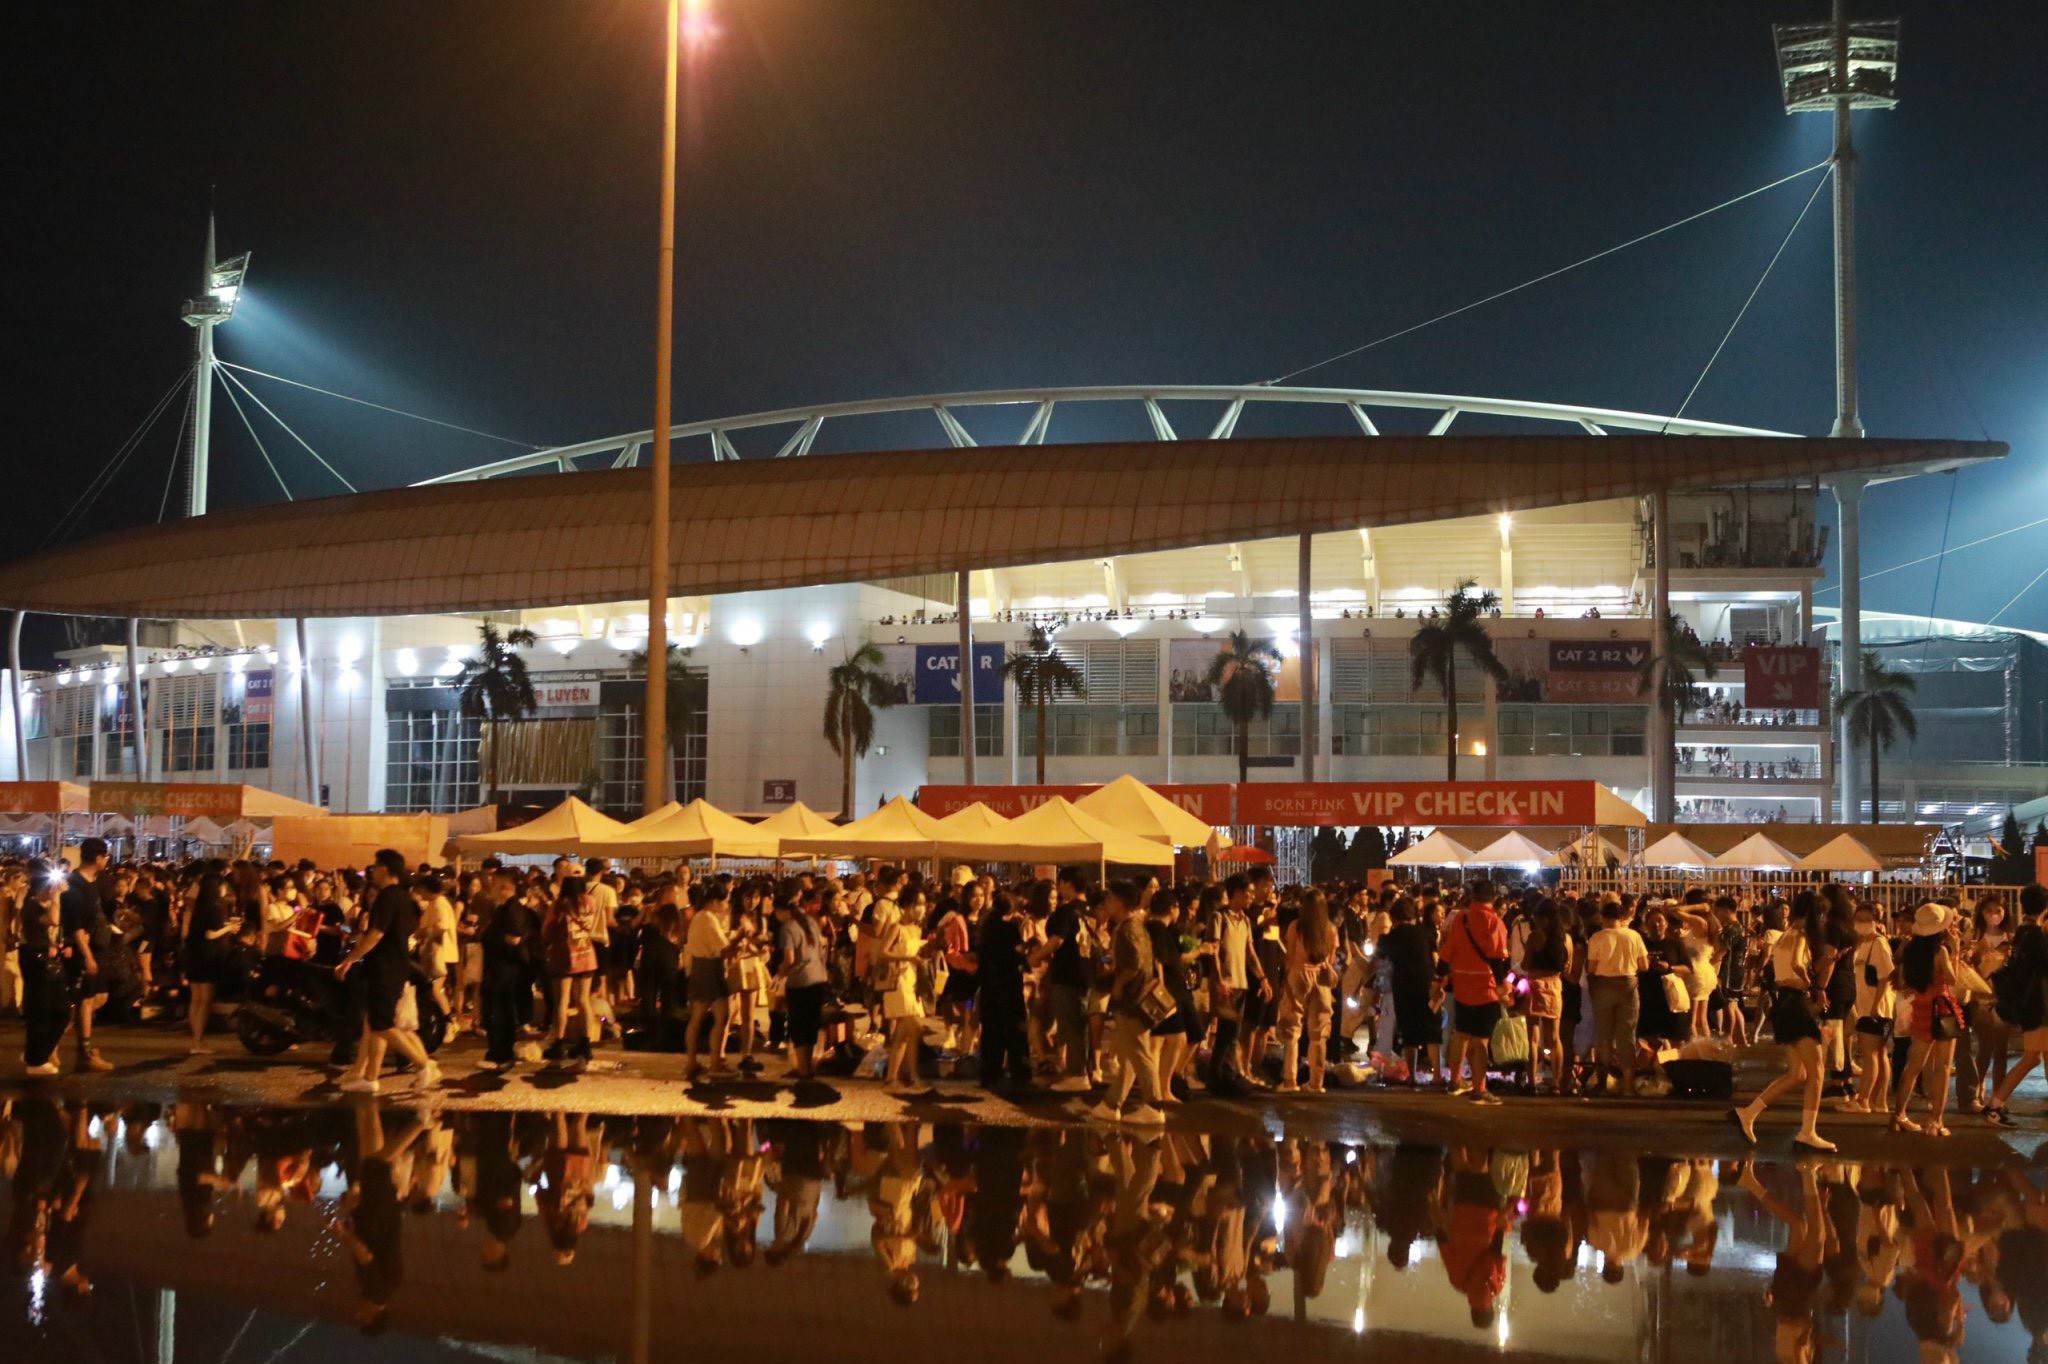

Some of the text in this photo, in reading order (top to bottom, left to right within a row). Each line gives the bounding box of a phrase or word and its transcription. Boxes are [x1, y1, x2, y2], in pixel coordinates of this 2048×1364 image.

[1557, 650, 1621, 661] CAT 2 R2
[926, 656, 958, 670] CAT
[1757, 654, 1808, 675] VIP
[1557, 680, 1583, 692] CAT
[1602, 681, 1622, 692] R2
[101, 791, 126, 806] CAT
[166, 793, 236, 808] CHECK-IN
[774, 786, 784, 800] B
[945, 800, 974, 812] BOR
[1264, 790, 1564, 816] BORN PINK VIP CHECK-IN
